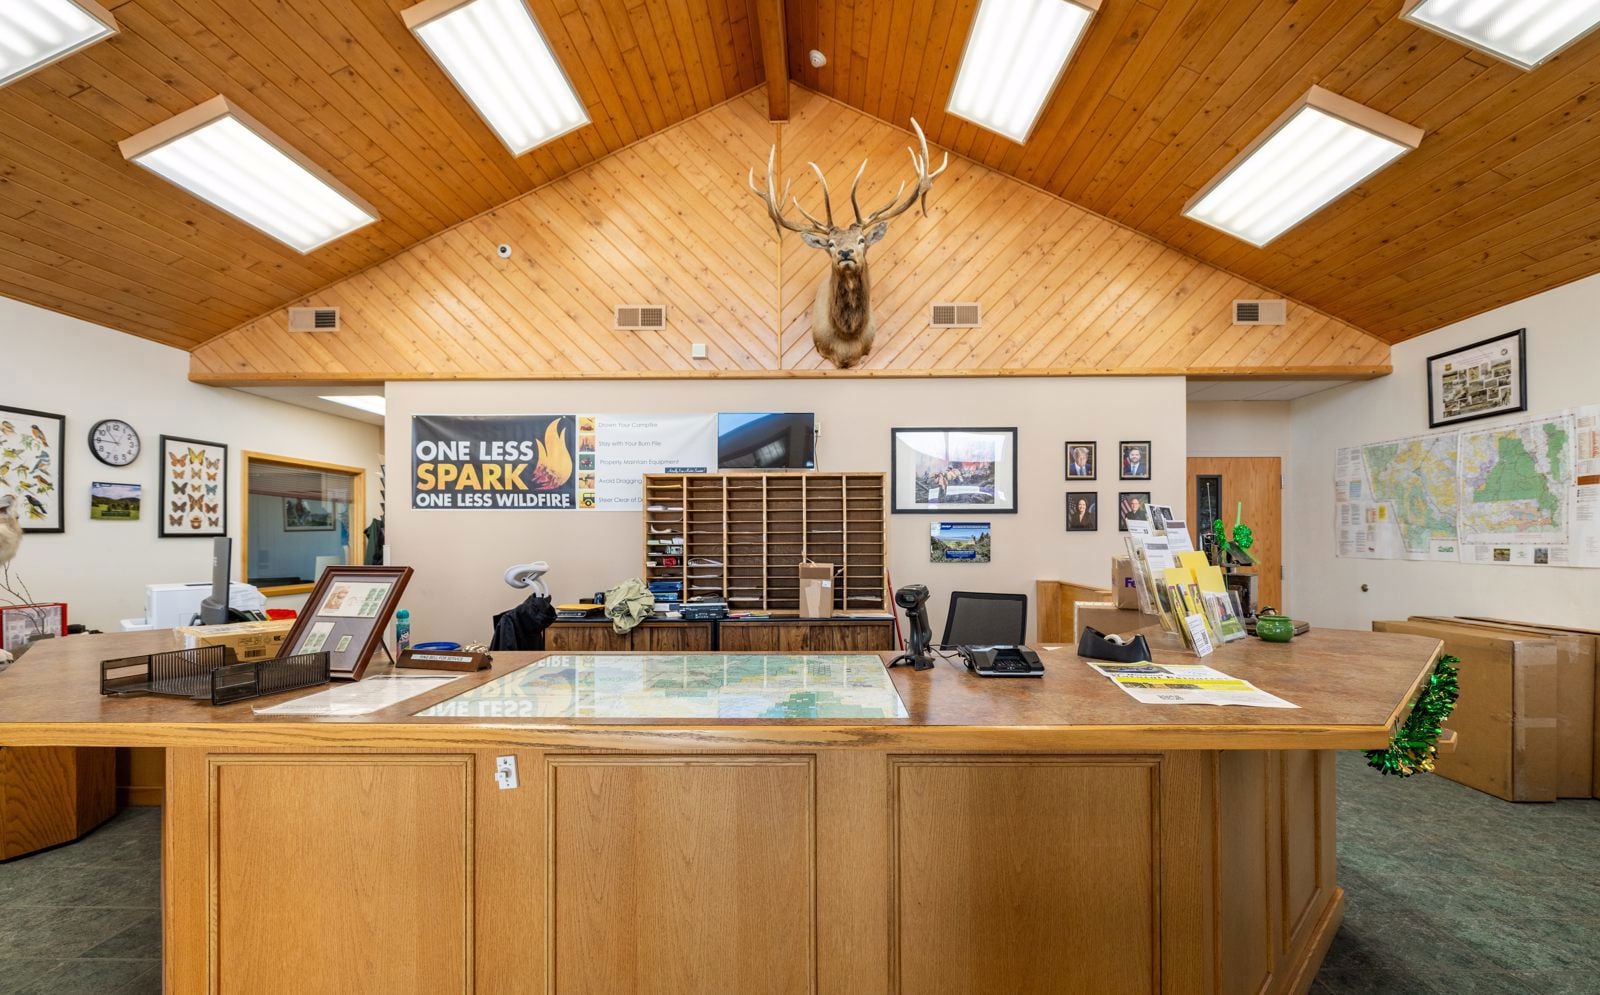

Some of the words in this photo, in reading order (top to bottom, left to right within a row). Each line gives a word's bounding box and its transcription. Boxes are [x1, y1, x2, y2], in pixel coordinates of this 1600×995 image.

[416, 440, 470, 461] ONE
[479, 440, 534, 461] LESS
[416, 463, 529, 491] SPARK
[416, 493, 450, 507] ONE
[458, 493, 493, 507] LESS
[495, 493, 570, 508] WILDFIRE
